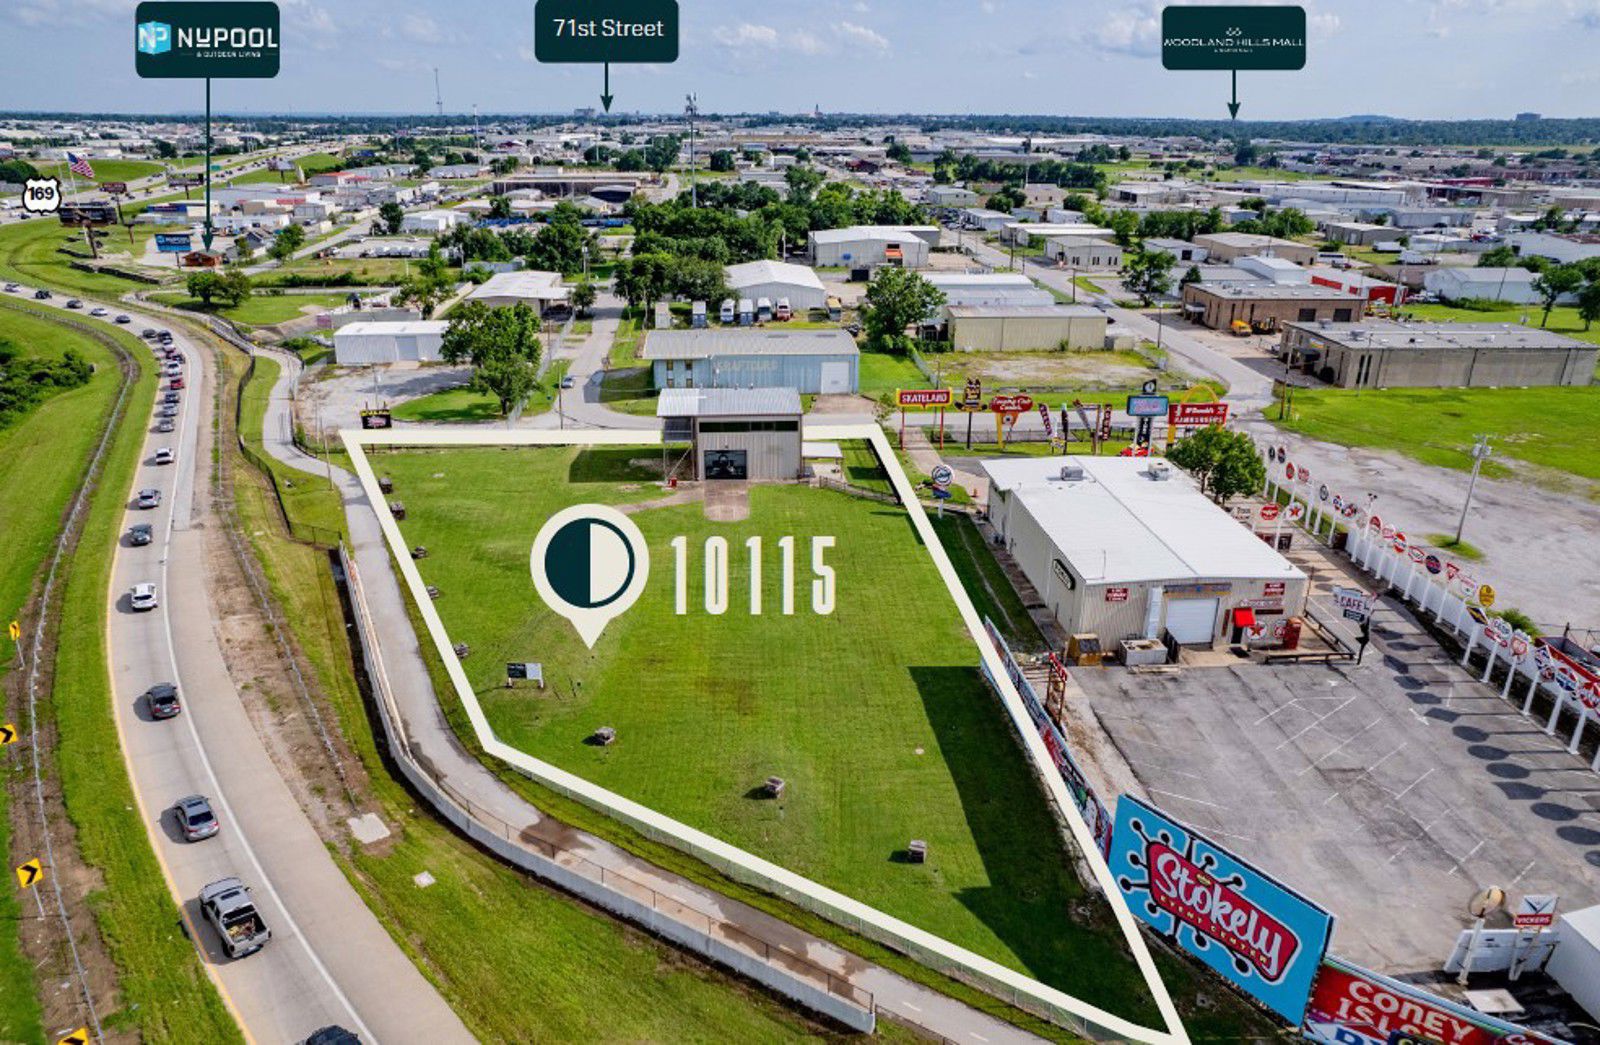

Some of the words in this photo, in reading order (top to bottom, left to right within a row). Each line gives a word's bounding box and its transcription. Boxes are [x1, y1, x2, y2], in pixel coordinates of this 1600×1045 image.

[901, 392, 948, 404] SKATELAND
[1155, 852, 1282, 976] Stokely
[1159, 895, 1203, 924] EVENT
[1210, 925, 1267, 963] CENTER
[1349, 980, 1476, 1040] CONEY
